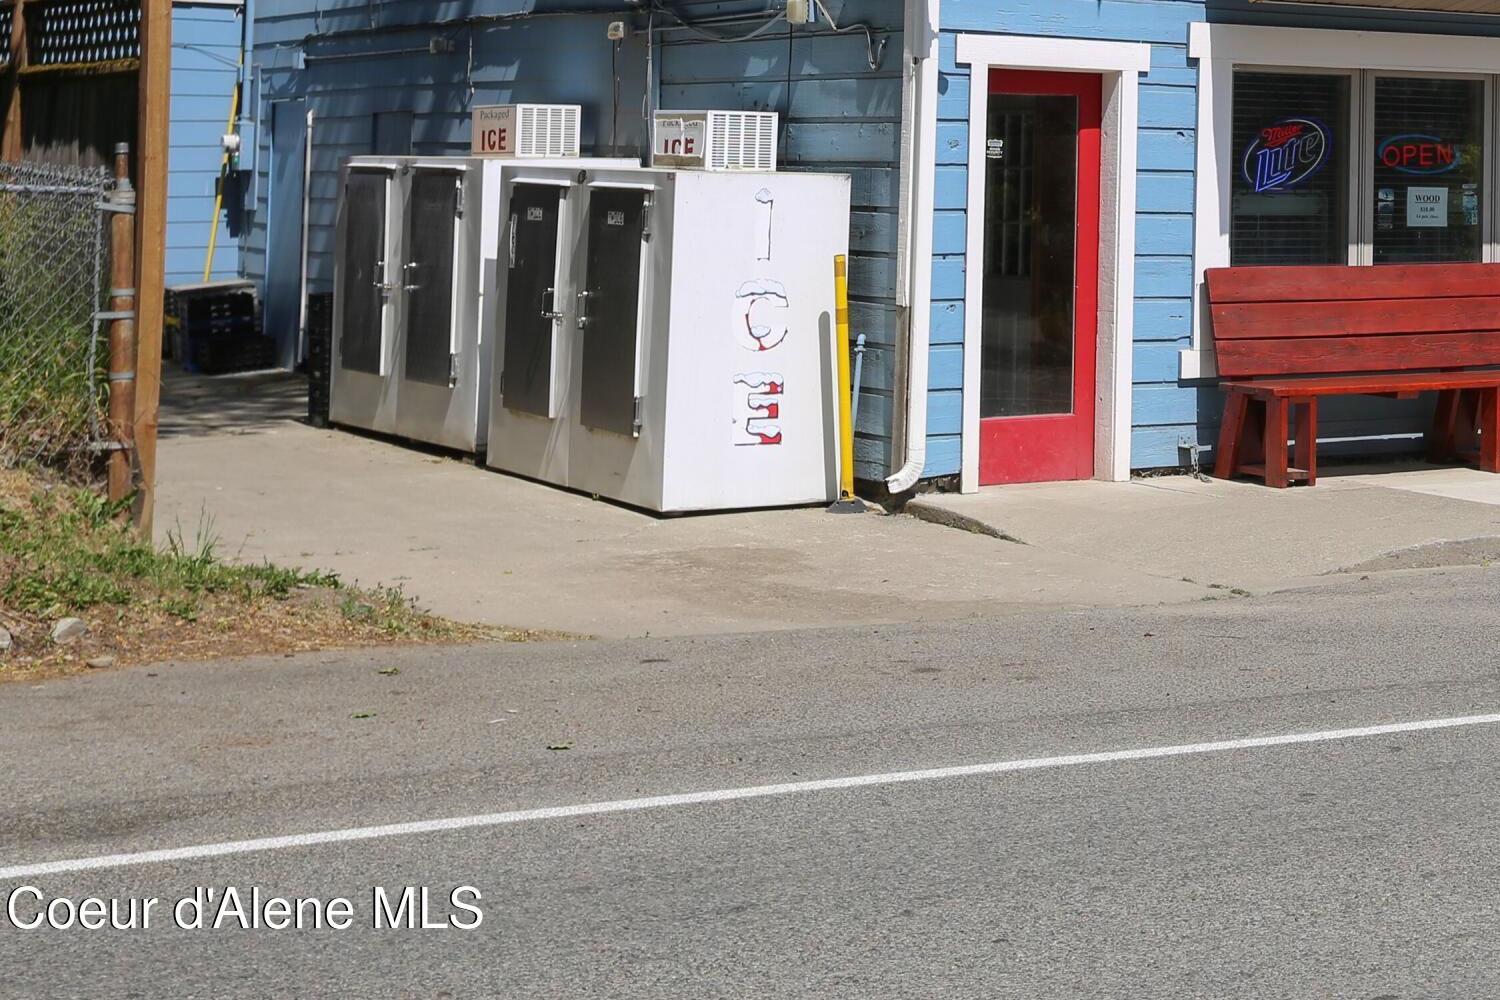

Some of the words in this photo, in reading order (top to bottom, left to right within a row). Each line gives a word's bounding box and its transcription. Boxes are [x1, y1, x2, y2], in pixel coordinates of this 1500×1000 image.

[480, 109, 510, 120] Packaged
[481, 127, 507, 151] ICE
[1262, 125, 1304, 145] Miller
[1255, 132, 1320, 192] Lite
[1383, 143, 1454, 168] OPEN
[1415, 194, 1441, 203] WOOD
